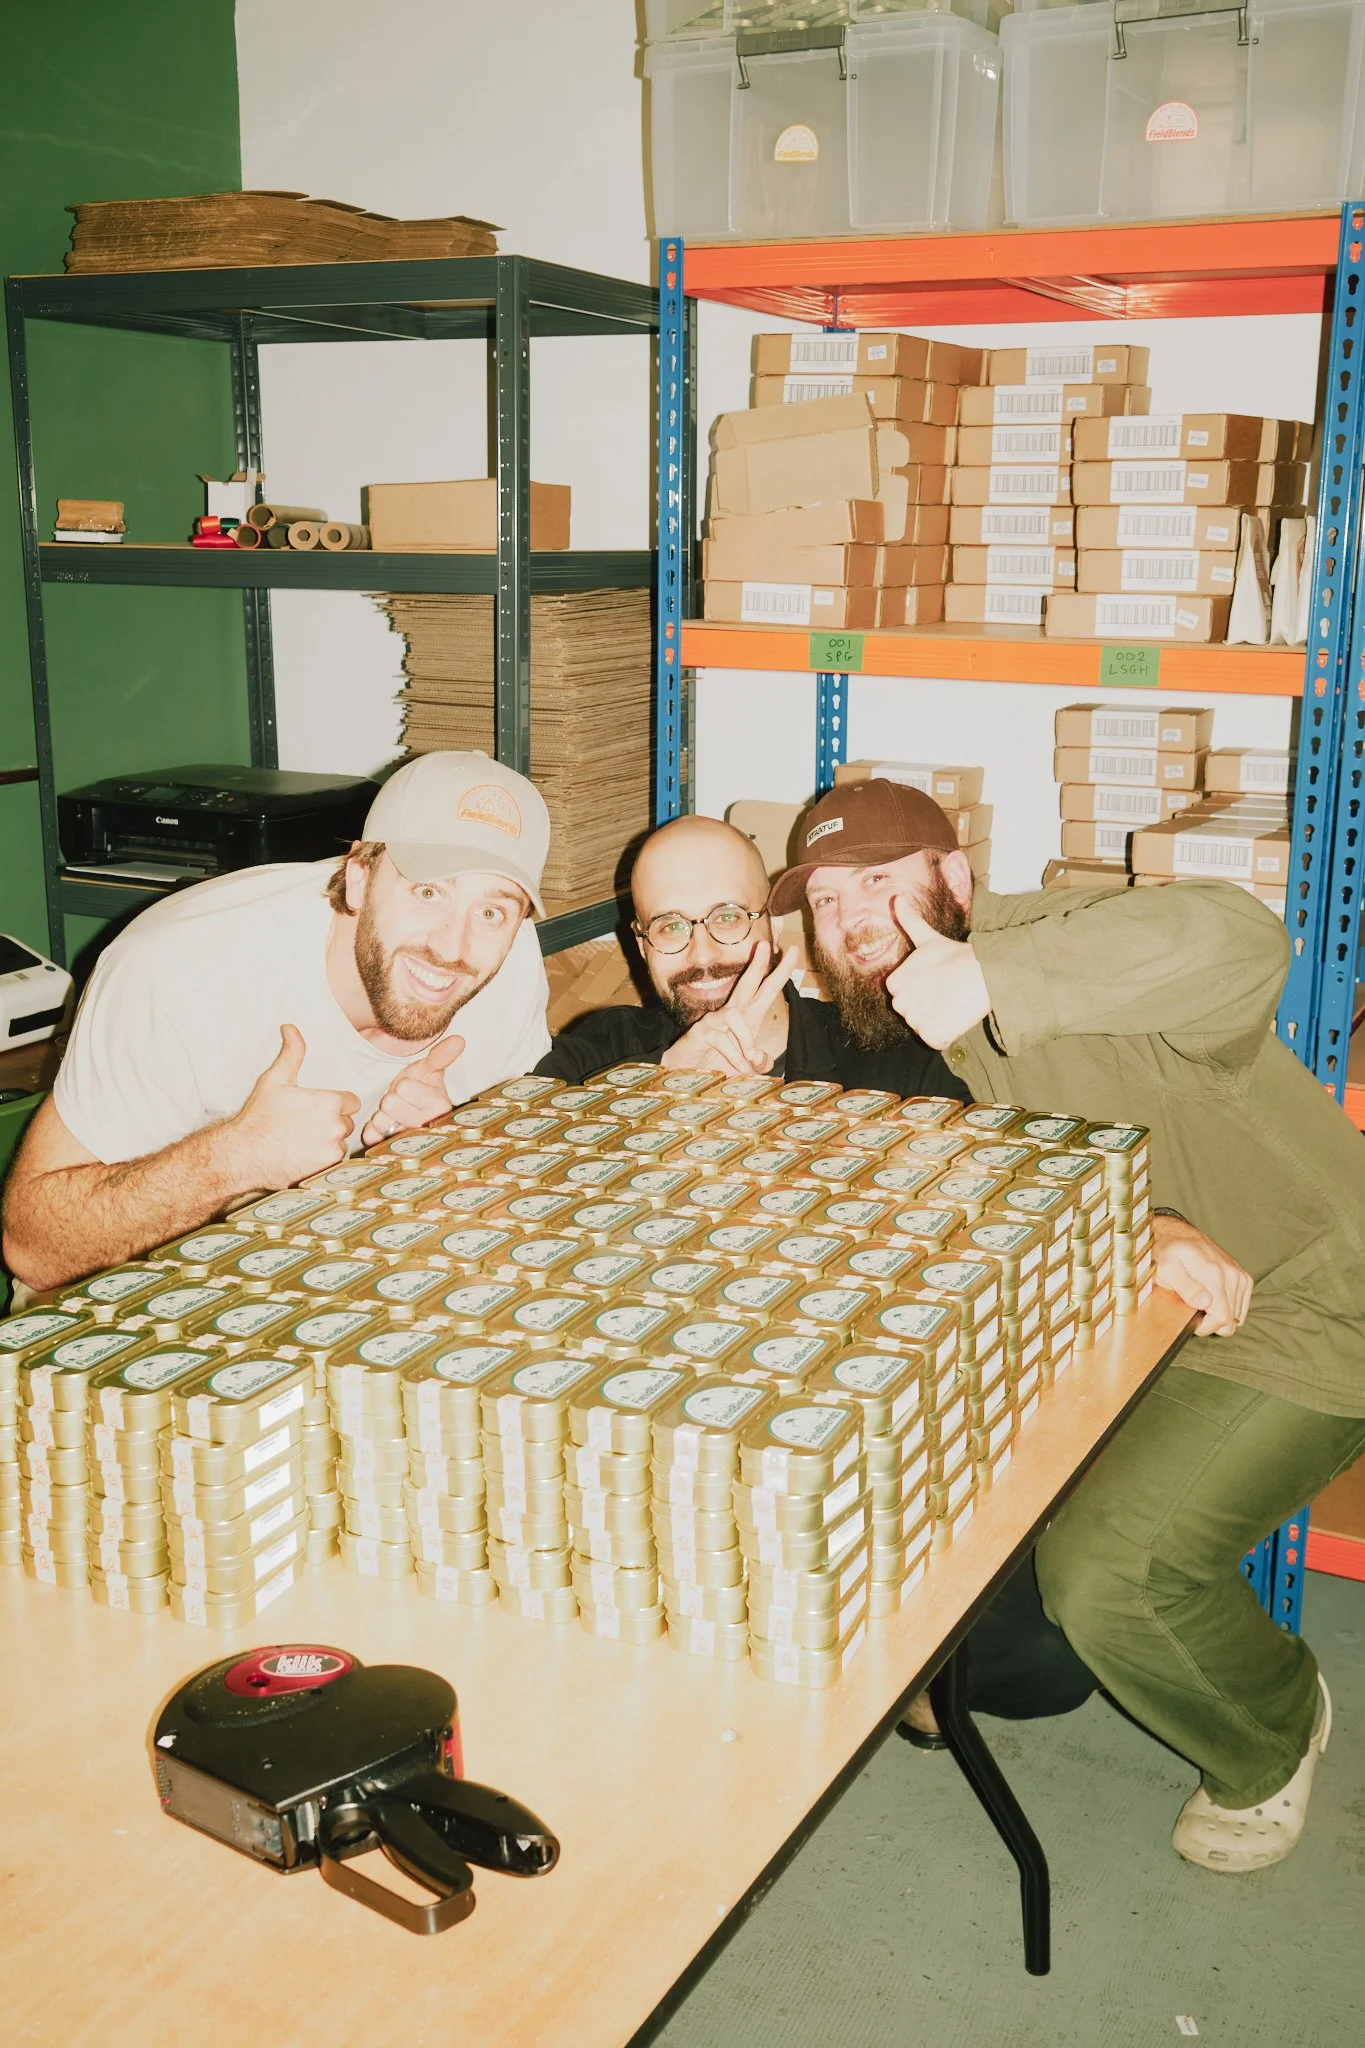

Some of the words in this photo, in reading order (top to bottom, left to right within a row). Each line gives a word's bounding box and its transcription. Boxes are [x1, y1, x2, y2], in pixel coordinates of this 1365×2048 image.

[1148, 128, 1195, 138] FieldBlends
[826, 650, 853, 662] SPG
[829, 639, 851, 649] 001
[1116, 651, 1146, 661] 002
[155, 815, 179, 826] Canon
[108, 1274, 160, 1298] FieldBlends
[167, 1291, 219, 1317] FieldBlends
[12, 1318, 70, 1345] FieldBlends
[239, 1306, 287, 1333] FieldBlends
[319, 1314, 366, 1343] FieldBlends
[77, 1337, 130, 1365] FieldBlends
[146, 1356, 201, 1386] FieldBlends
[233, 1364, 288, 1395] FieldBlends
